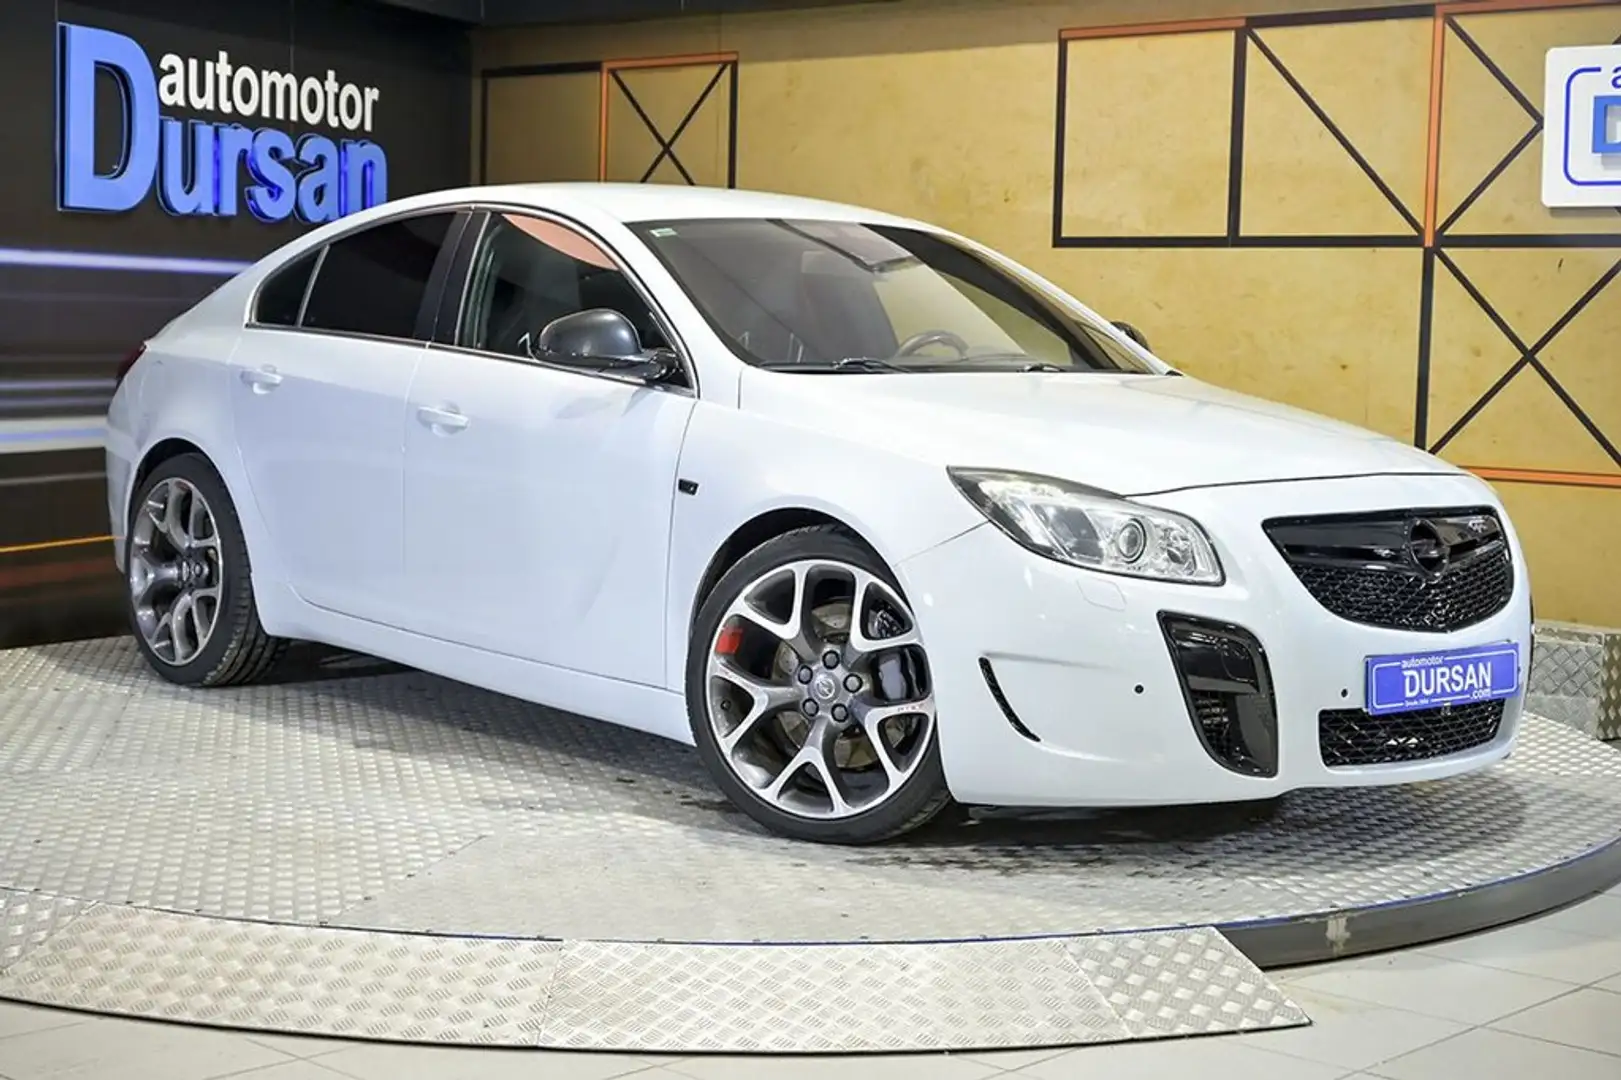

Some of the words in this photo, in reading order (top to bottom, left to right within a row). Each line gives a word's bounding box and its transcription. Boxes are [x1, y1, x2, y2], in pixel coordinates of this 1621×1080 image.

[159, 51, 379, 132] automotor
[57, 21, 387, 223] Dursan
[1401, 656, 1444, 669] automotor
[1402, 662, 1492, 698] DURSAN
